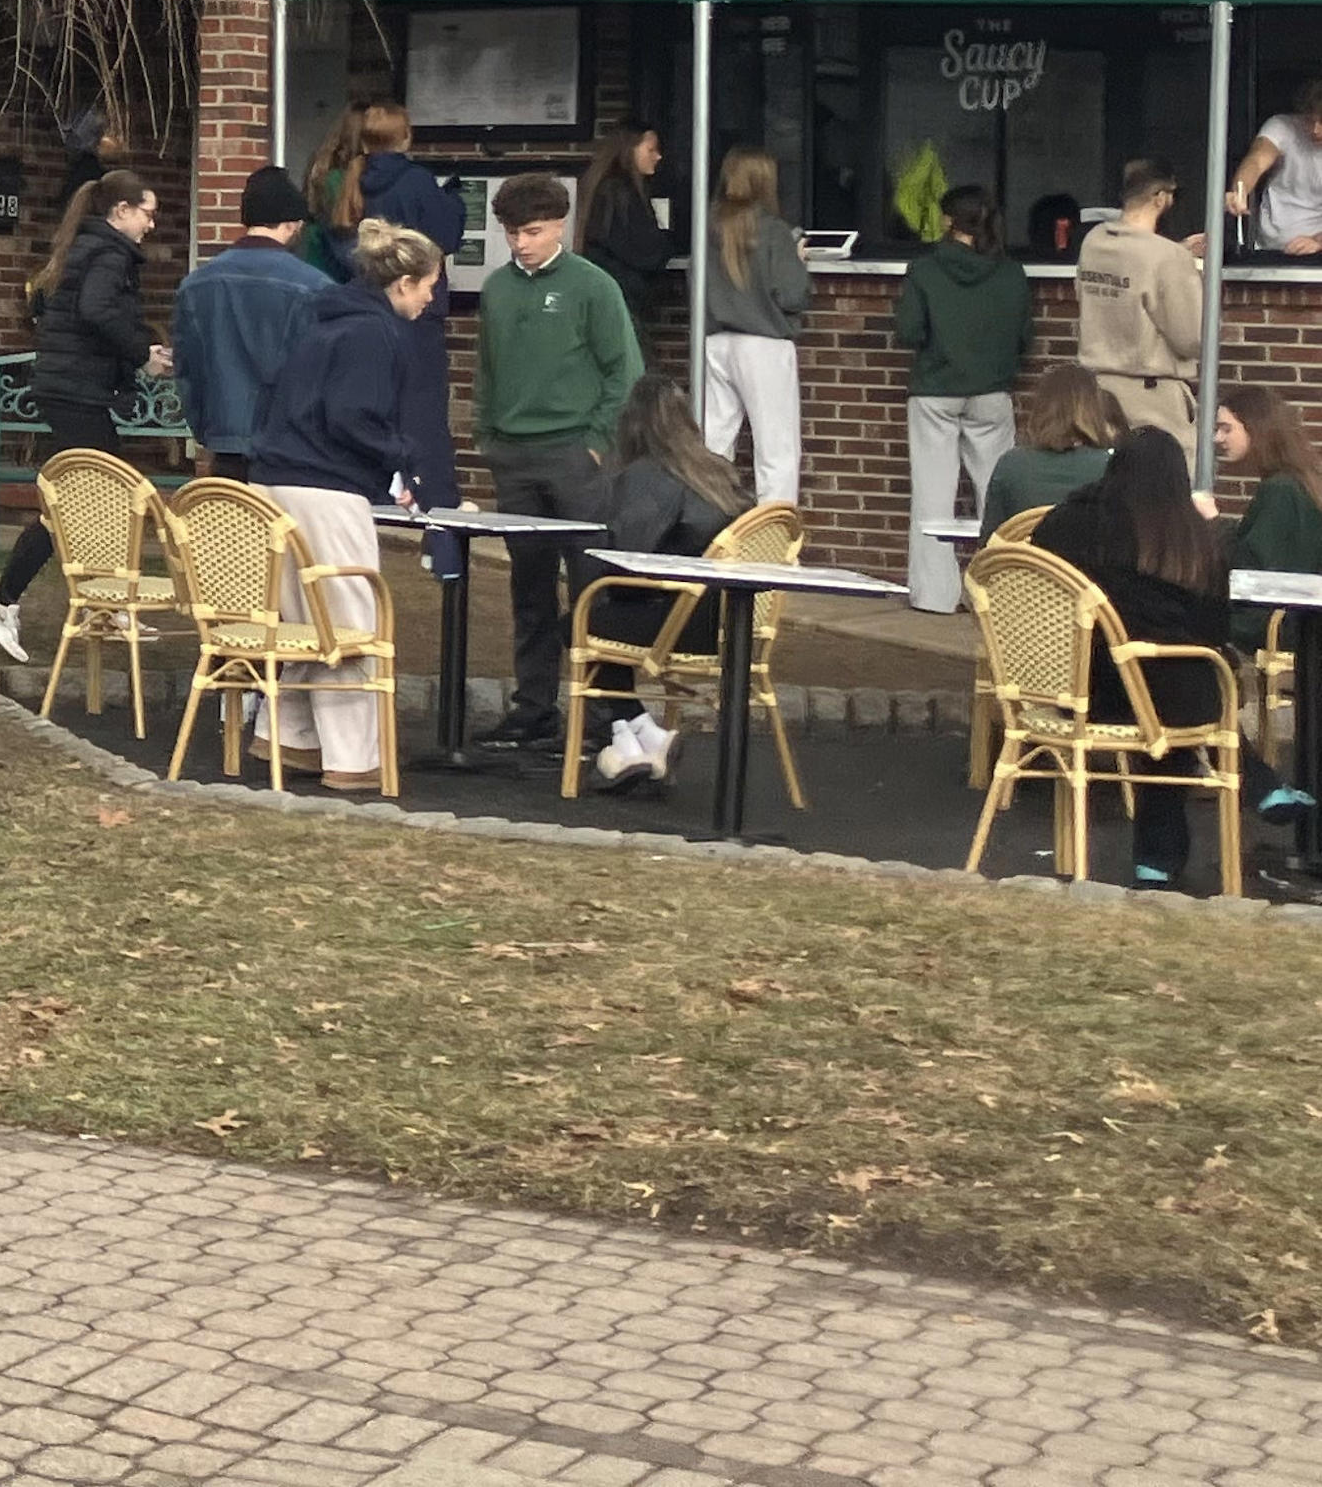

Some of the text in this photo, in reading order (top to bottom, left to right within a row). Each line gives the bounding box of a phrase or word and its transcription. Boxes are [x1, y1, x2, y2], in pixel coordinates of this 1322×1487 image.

[977, 18, 1012, 31] THE
[941, 28, 1046, 90] Saucy
[959, 75, 1022, 110] CUP
